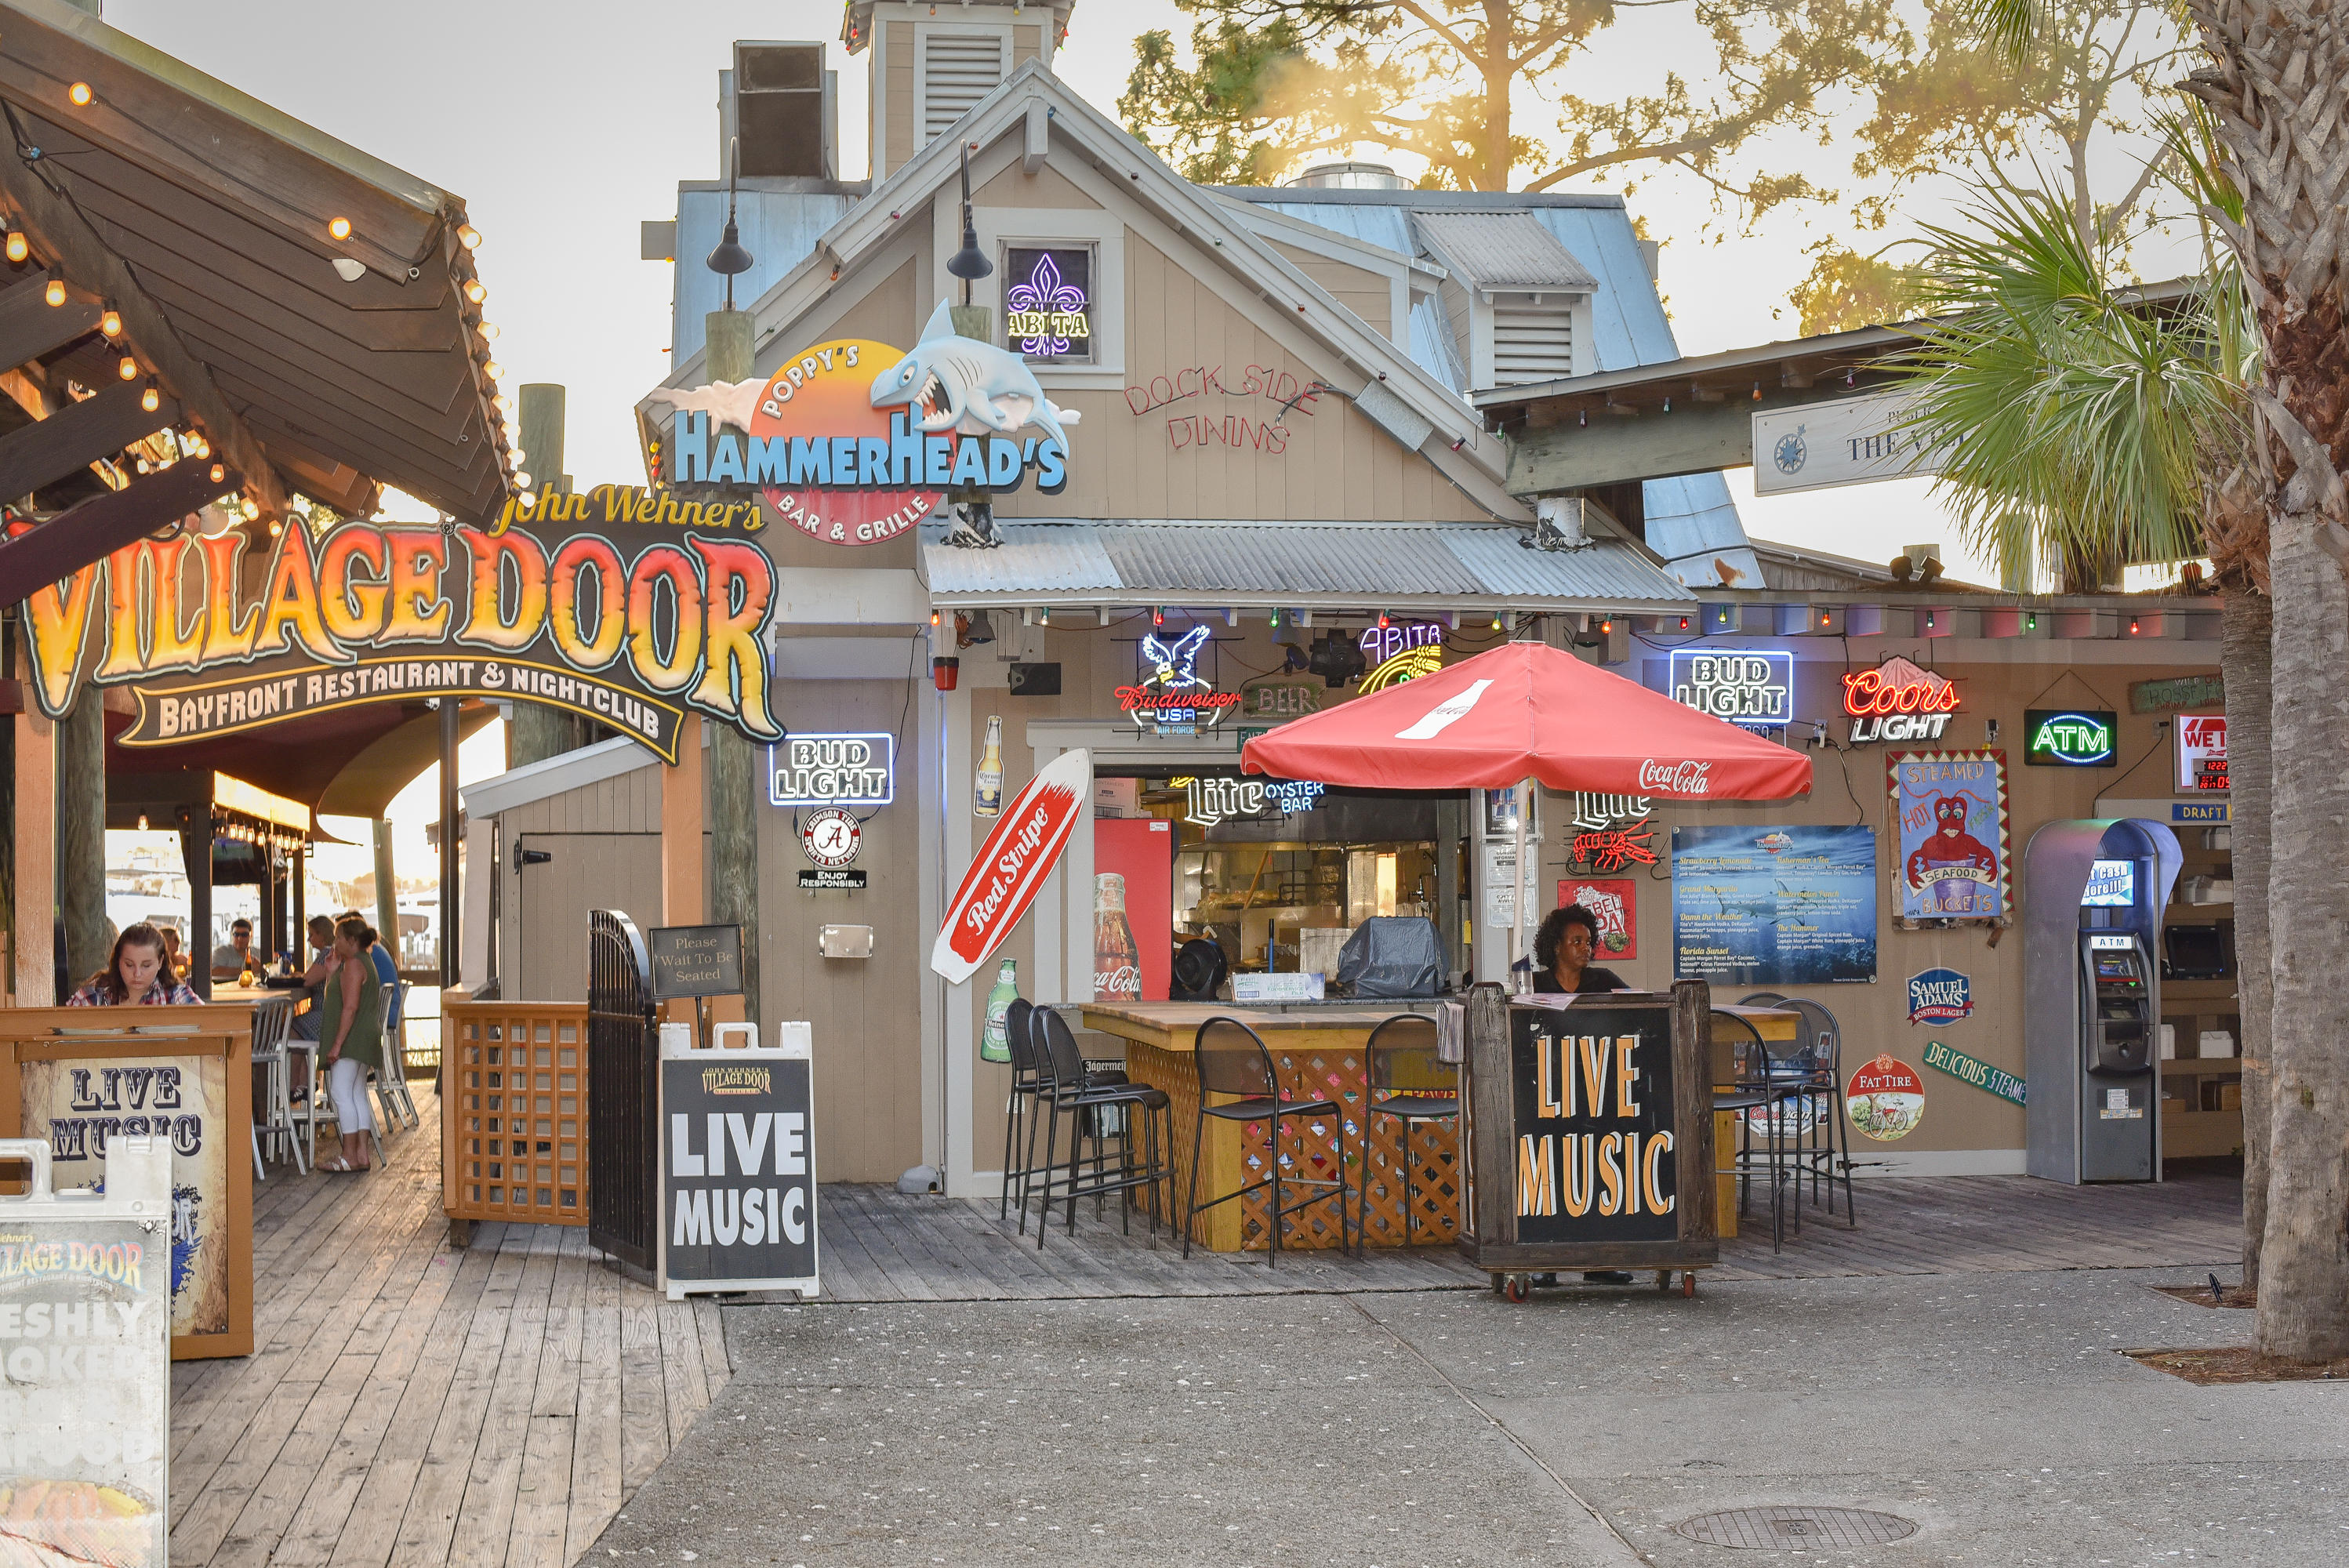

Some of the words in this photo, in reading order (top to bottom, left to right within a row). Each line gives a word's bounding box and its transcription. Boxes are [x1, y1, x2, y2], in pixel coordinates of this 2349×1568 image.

[1008, 312, 1089, 337] ABITA
[761, 345, 859, 419] POPPY'S
[1124, 365, 1224, 416] DOCK
[1243, 364, 1327, 416] SIDE
[1168, 416, 1291, 455] DINING
[1846, 432, 1901, 461] THE
[488, 481, 593, 537] John
[593, 484, 768, 532] Wehner's
[777, 494, 822, 535] BAR
[830, 523, 846, 542] &
[857, 495, 931, 543] GRILLE
[4, 510, 451, 710] VILLAGE
[457, 527, 782, 739] DOOR
[1360, 624, 1441, 664] ABITA
[1692, 656, 1772, 687] BUD
[159, 677, 298, 739] BAYFRONT
[307, 661, 475, 706] RESTAURANT
[480, 661, 506, 689] &
[512, 666, 660, 739] NIGHTCLUB
[1114, 684, 1242, 711] Budweiser
[1258, 685, 1316, 713] BEER
[1676, 684, 1787, 715] LIGHT
[1843, 670, 1960, 715] Coors
[1156, 708, 1196, 722] USA
[1852, 713, 1952, 742] LIGHT
[1157, 724, 1171, 735] AIR
[2033, 725, 2108, 753] ATM
[2184, 732, 2214, 748] WE
[791, 739, 871, 769] BUD
[775, 768, 888, 800] LIGHT
[1639, 757, 1713, 794] Coca-Cola
[1908, 763, 1985, 784] STEAMED
[1184, 777, 1265, 827] Lite
[1265, 781, 1325, 799] OYSTER
[1281, 797, 1313, 814] BAR
[1902, 802, 1932, 834] HOT
[2183, 806, 2223, 818] DRAFT
[806, 810, 840, 833] CRIMSON
[841, 813, 858, 832] TIDE
[804, 836, 827, 865] SPORTS
[827, 836, 860, 866] NETWORK
[819, 825, 844, 849] A
[966, 876, 1008, 936] Red
[998, 806, 1049, 885] Stripe
[1679, 856, 1717, 866] Strawberry
[2099, 864, 2129, 880] Cash
[800, 879, 865, 887] RESPONSIBLY
[818, 871, 848, 880] ENJOY
[1926, 868, 1978, 883] SEAFOOD
[1679, 913, 1701, 921] Damn
[1922, 895, 1992, 913] BUCKETS
[676, 938, 717, 949] Please
[660, 954, 691, 967] Wait
[695, 953, 712, 964] To
[716, 952, 733, 964] Be
[676, 967, 721, 982] Seated
[1094, 965, 1141, 993] ca-Cola
[1910, 978, 1968, 997] SAMUEL
[1913, 1008, 1941, 1021] BOSTON
[1942, 1008, 1966, 1017] LAGER
[1915, 993, 1964, 1011] ADAMS
[988, 1020, 1005, 1029] Heine
[1537, 1034, 1641, 1120] LIVE
[1925, 1041, 1990, 1086] DELICIOUS
[71, 1066, 181, 1112] LIVE
[702, 1073, 742, 1095] VILLAGE
[744, 1073, 772, 1095] DOOR
[1859, 1075, 1882, 1088] FAT
[1882, 1074, 1912, 1087] TIRE
[49, 1114, 201, 1162] MUSIC
[671, 1112, 806, 1177] LIVE
[1518, 1131, 1675, 1218] MUSIC
[673, 1186, 806, 1247] MUSIC
[0, 1232, 34, 1243] ehner's
[0, 1241, 64, 1277] LAGE
[67, 1241, 147, 1294] DOOR
[0, 1301, 147, 1338] ESHLY
[0, 1345, 146, 1380] OKED
